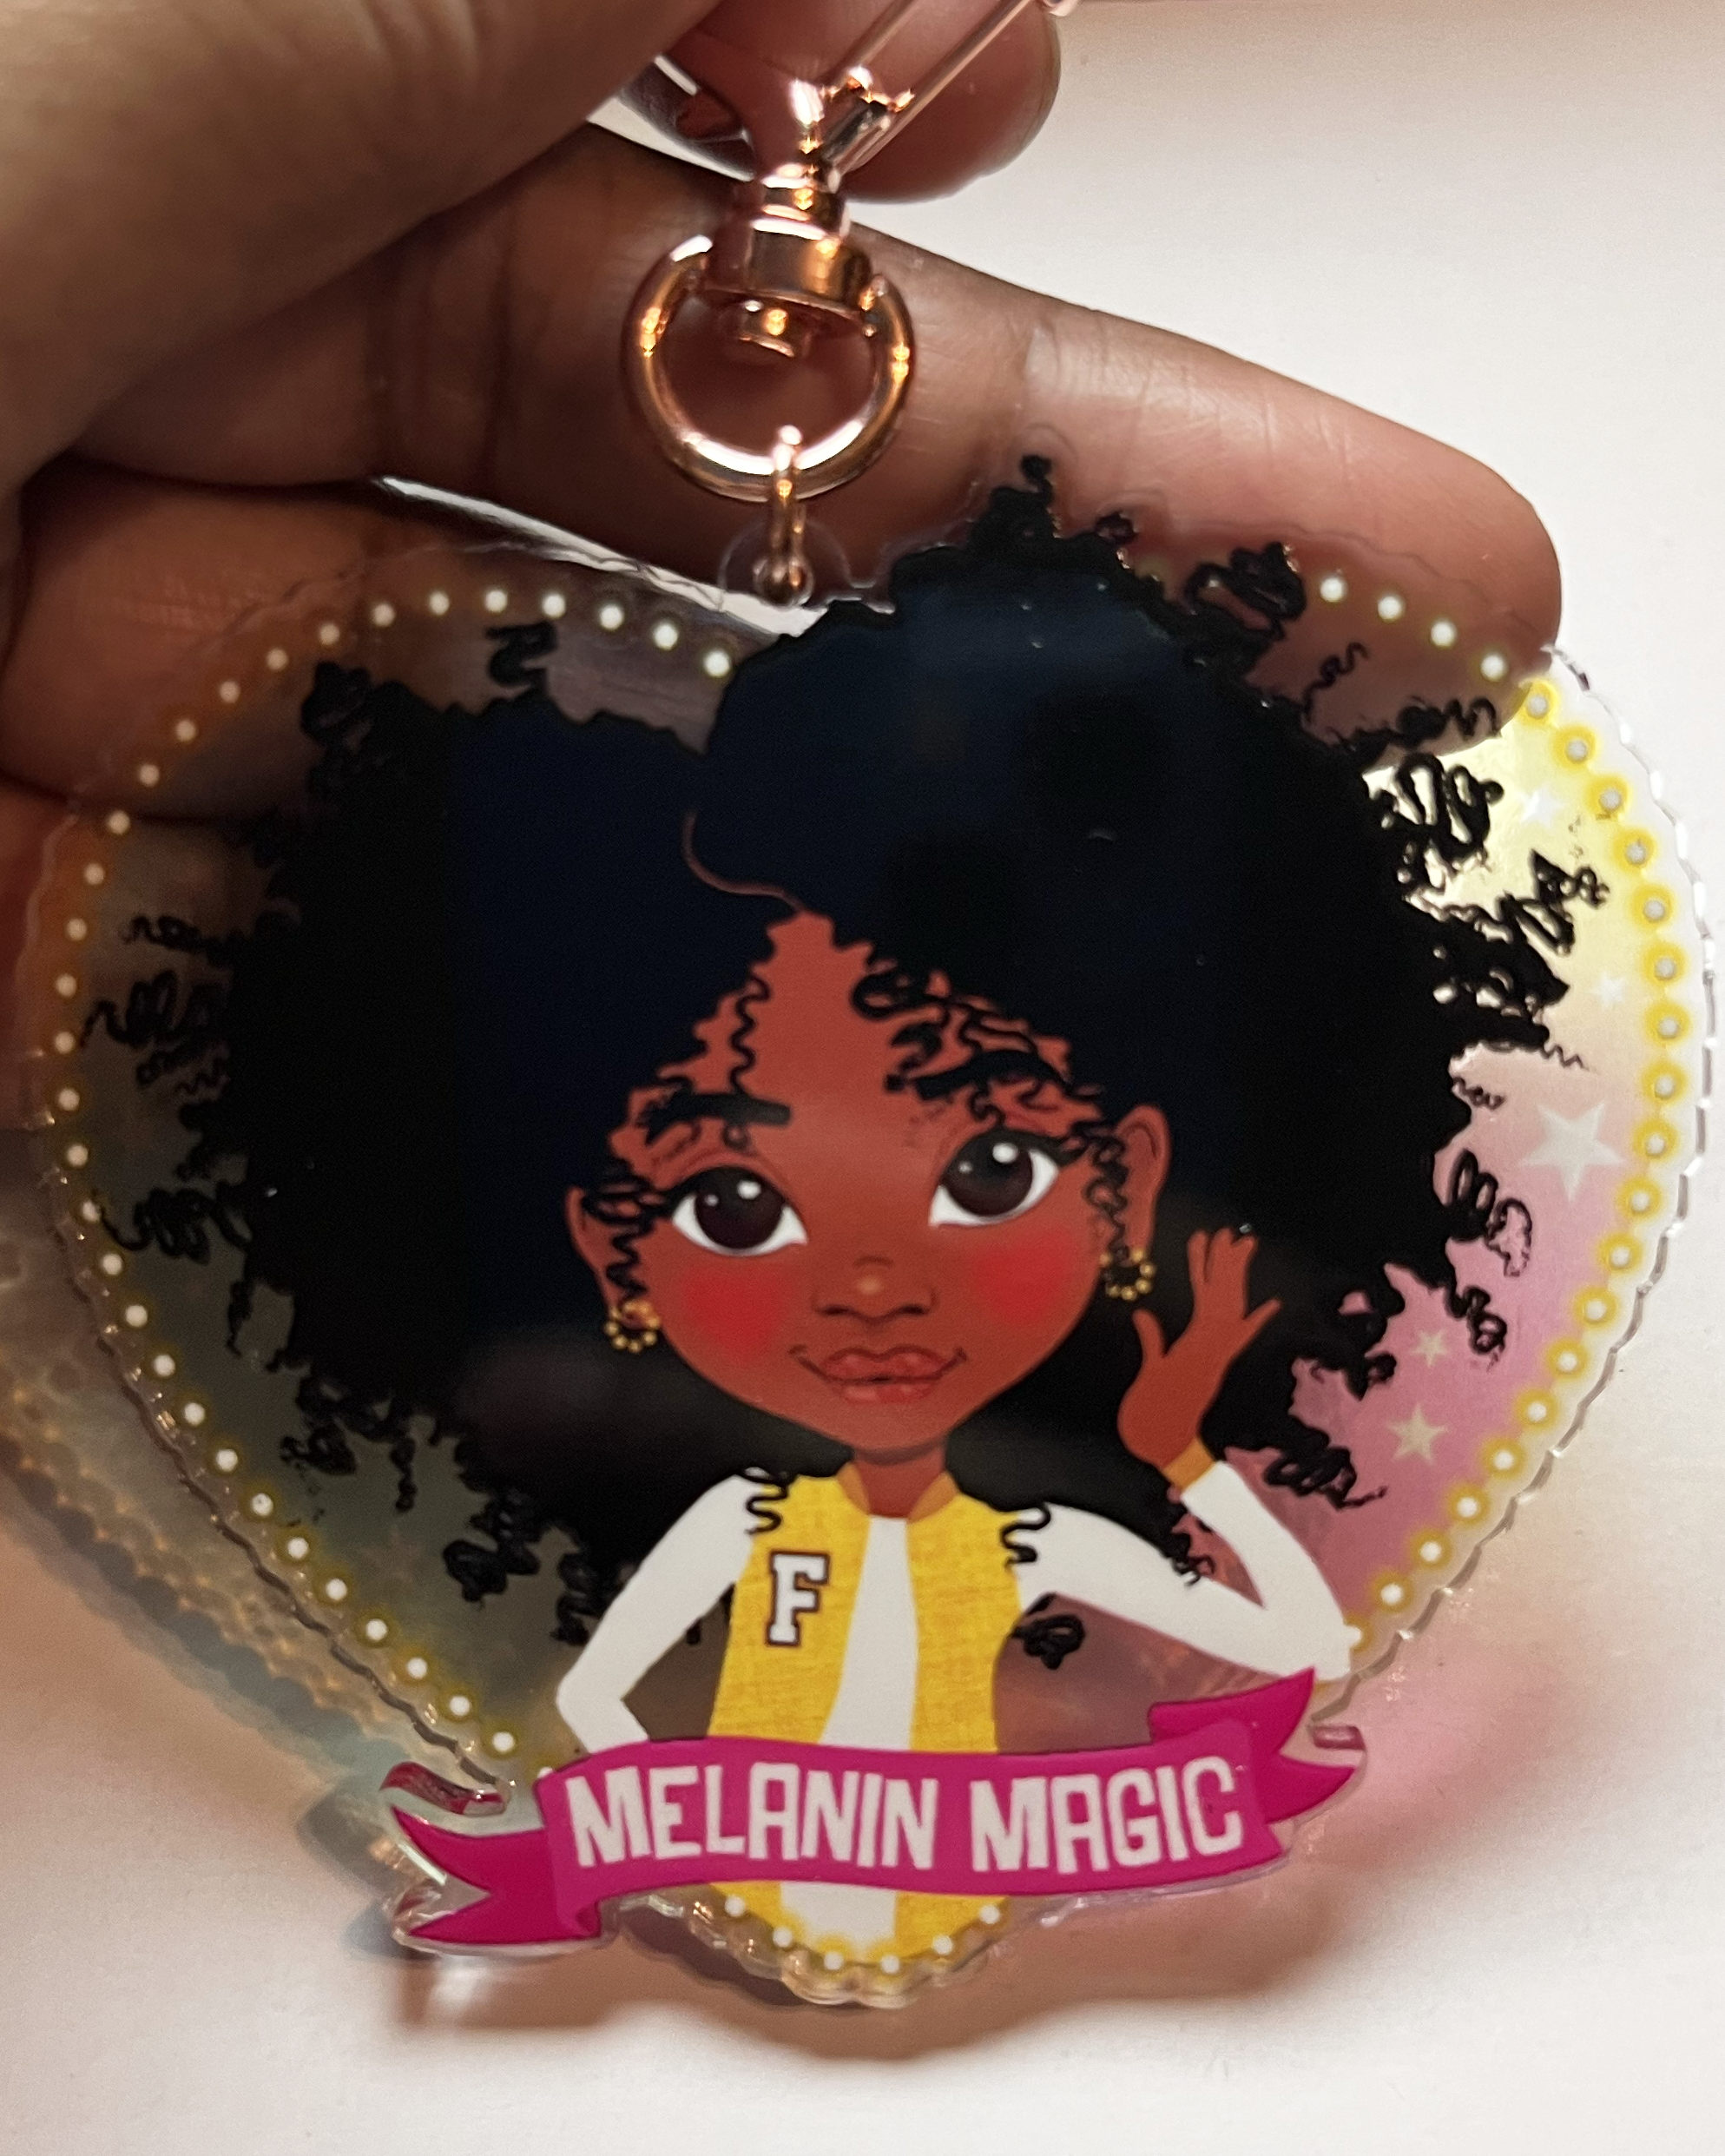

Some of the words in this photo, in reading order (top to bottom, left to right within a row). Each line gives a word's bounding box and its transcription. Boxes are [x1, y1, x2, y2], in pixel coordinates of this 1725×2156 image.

[767, 1550, 830, 1646] F
[565, 1762, 939, 1870] MELANIN
[971, 1756, 1244, 1874] MAGIC
